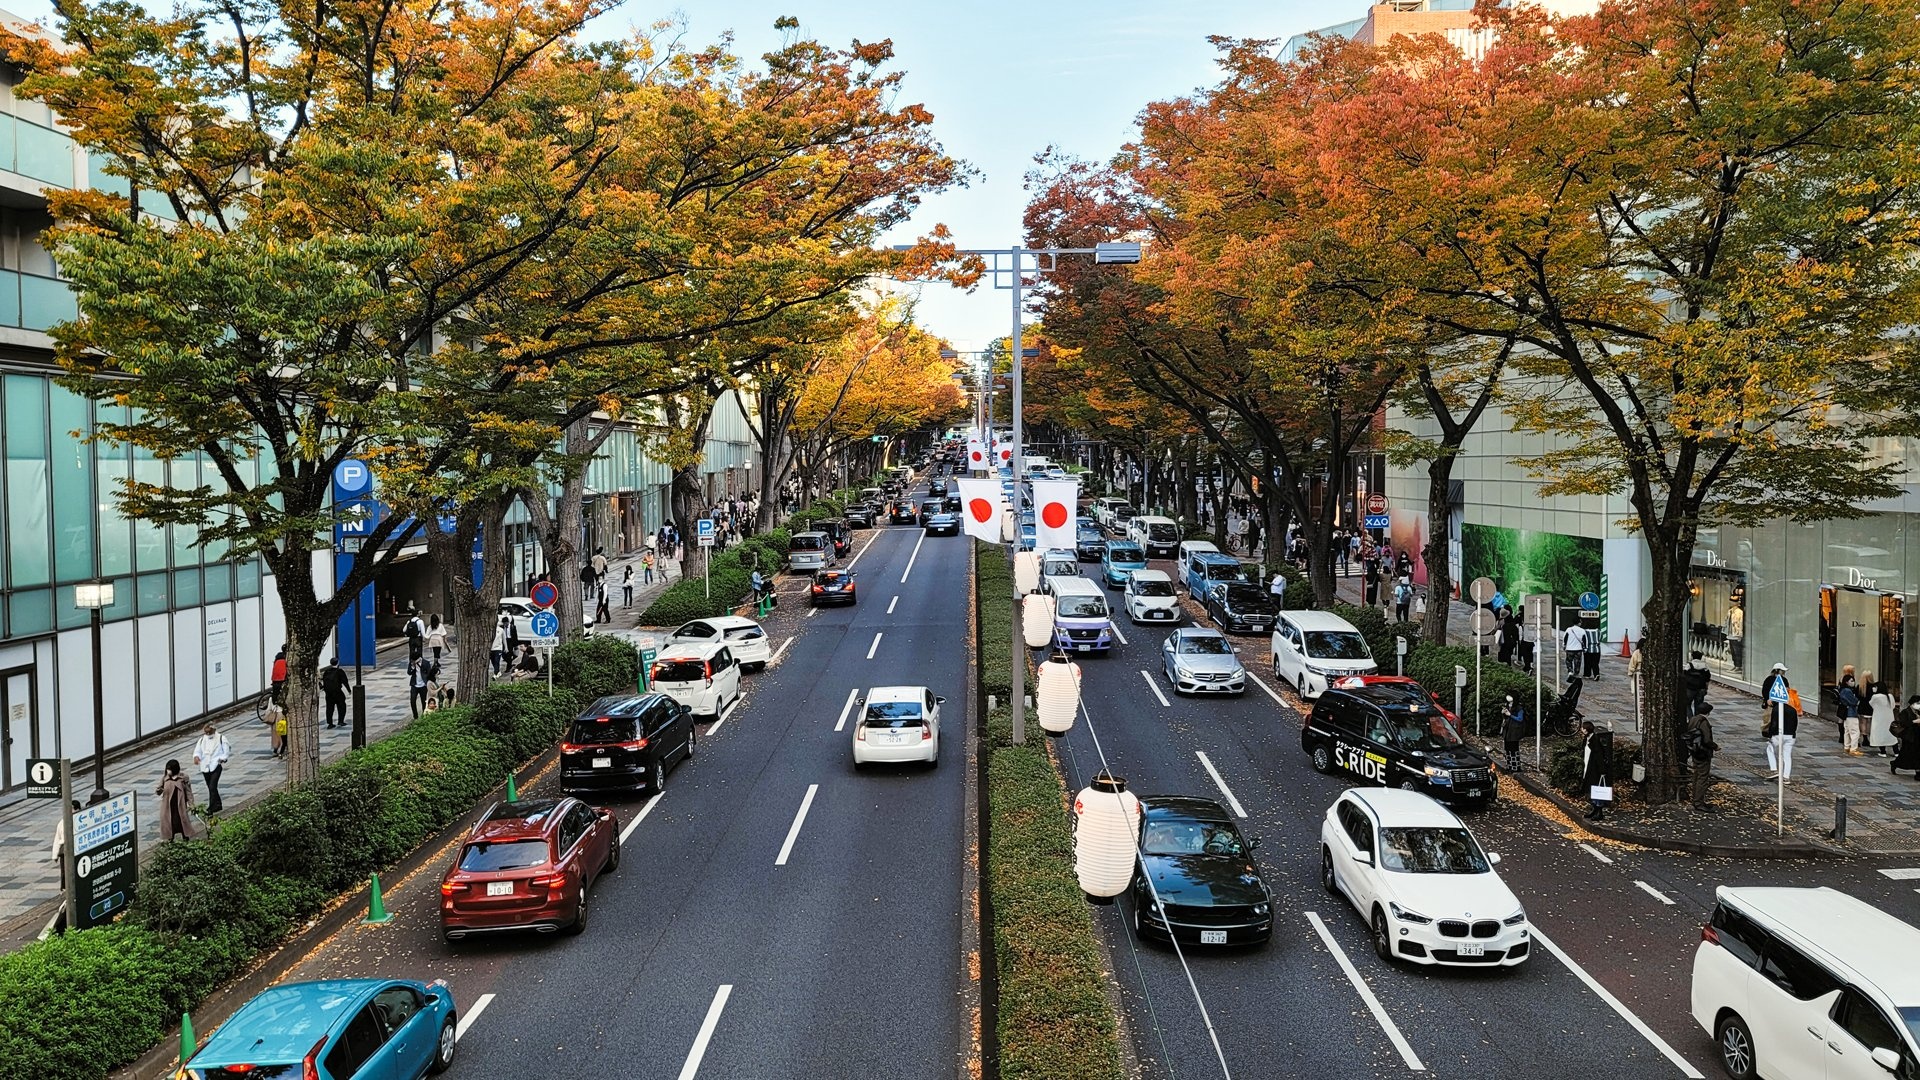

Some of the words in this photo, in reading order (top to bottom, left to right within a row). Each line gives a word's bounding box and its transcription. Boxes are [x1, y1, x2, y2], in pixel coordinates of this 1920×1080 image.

[343, 466, 361, 484] P
[342, 516, 363, 532] IN
[700, 521, 712, 534] P
[1707, 550, 1727, 568] Dior
[1848, 567, 1878, 590] Dior
[537, 618, 548, 635] P
[544, 626, 553, 635] 60
[1851, 620, 1866, 628] Dior
[1335, 747, 1387, 784] S.RIDE
[92, 840, 130, 864] 渋谷区エリアマップ
[92, 859, 107, 870] Shibuya
[107, 855, 116, 863] City
[116, 851, 124, 859] Area
[124, 847, 133, 856] Map
[493, 886, 512, 895] 10-10
[1207, 935, 1226, 943] 12-12
[1463, 947, 1483, 955] 34-12
